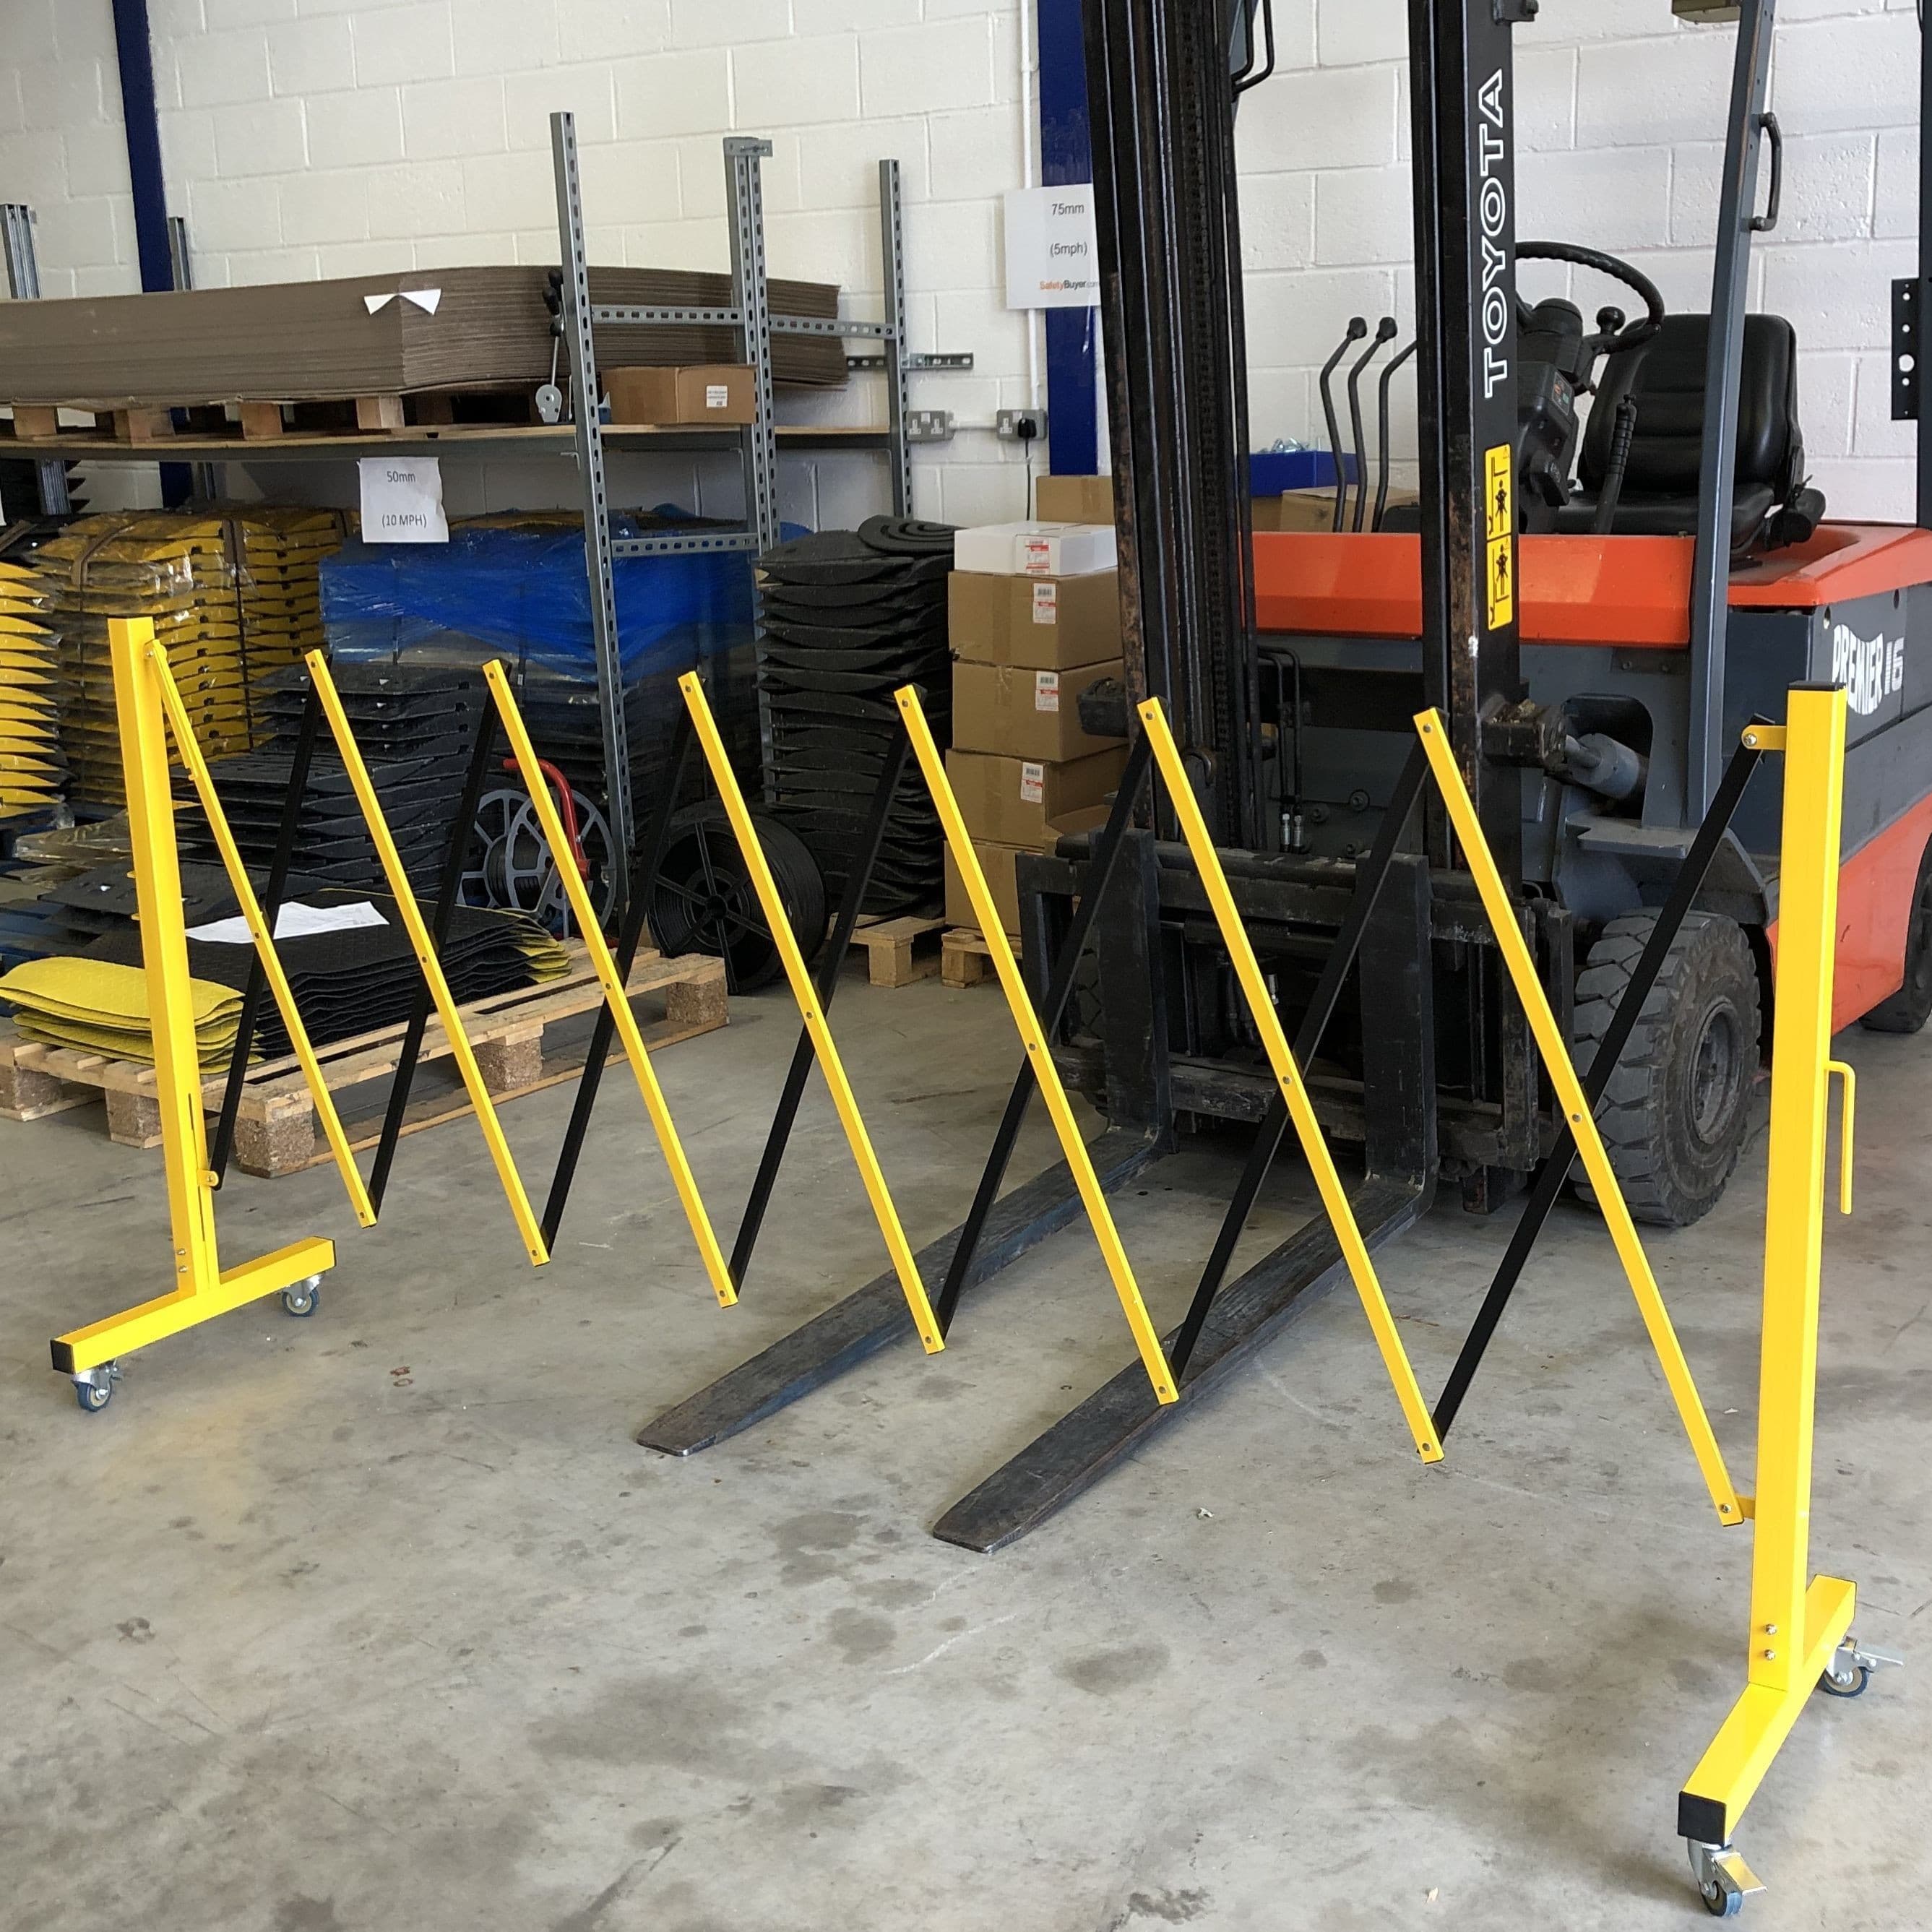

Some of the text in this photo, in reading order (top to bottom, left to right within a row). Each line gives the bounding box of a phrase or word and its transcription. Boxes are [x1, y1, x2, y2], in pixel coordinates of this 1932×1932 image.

[1051, 203, 1084, 215] 75mm
[1478, 69, 1508, 399] TOYOTA
[1050, 241, 1088, 258] (5mph)
[387, 470, 416, 483] 50mm
[381, 514, 427, 528] (10 MPH)
[1832, 624, 1905, 715] PREMIER 16
